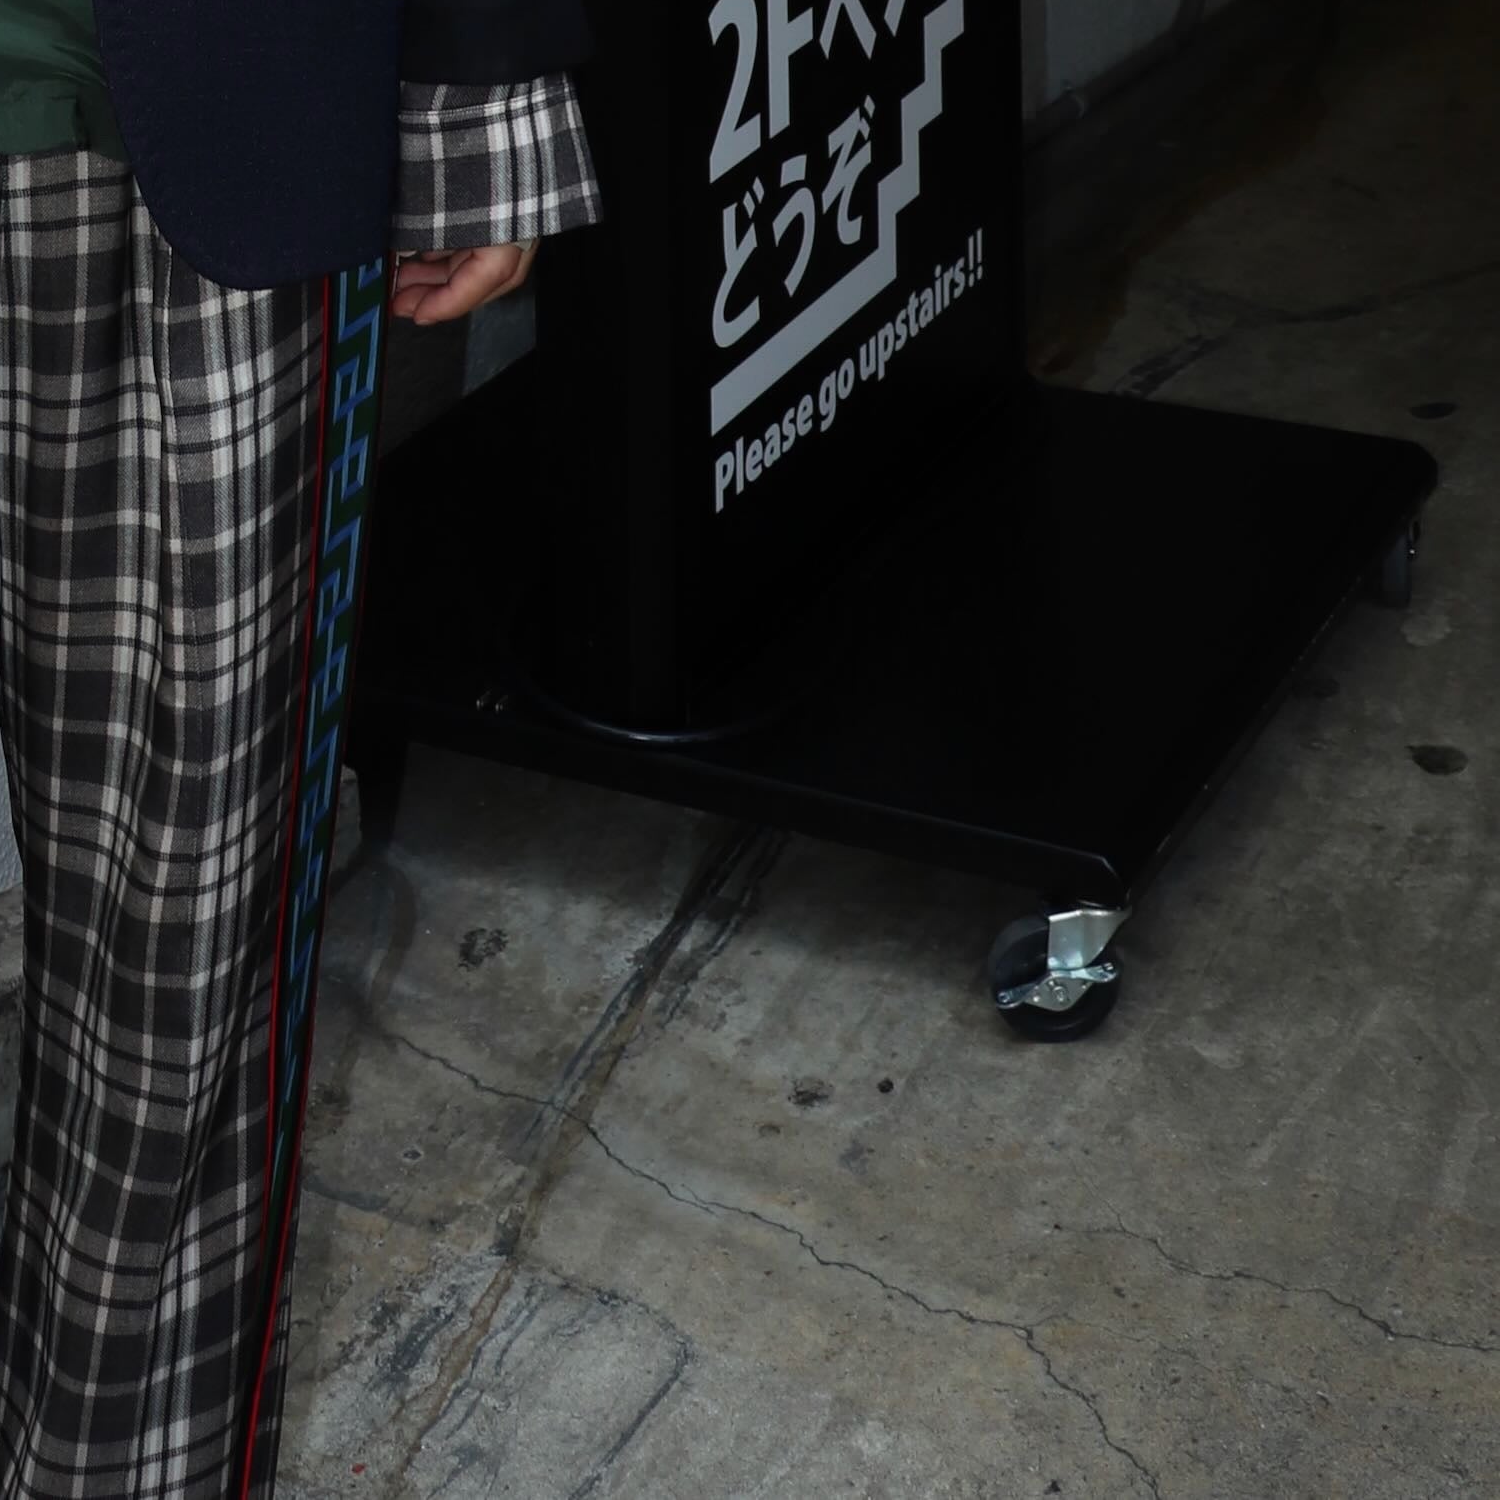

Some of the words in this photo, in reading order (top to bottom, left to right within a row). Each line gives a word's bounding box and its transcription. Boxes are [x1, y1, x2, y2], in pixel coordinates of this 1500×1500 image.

[711, 95, 875, 349] どうぞ
[714, 393, 814, 514] Please
[817, 357, 855, 434] go
[858, 228, 984, 382] upstairs!!
